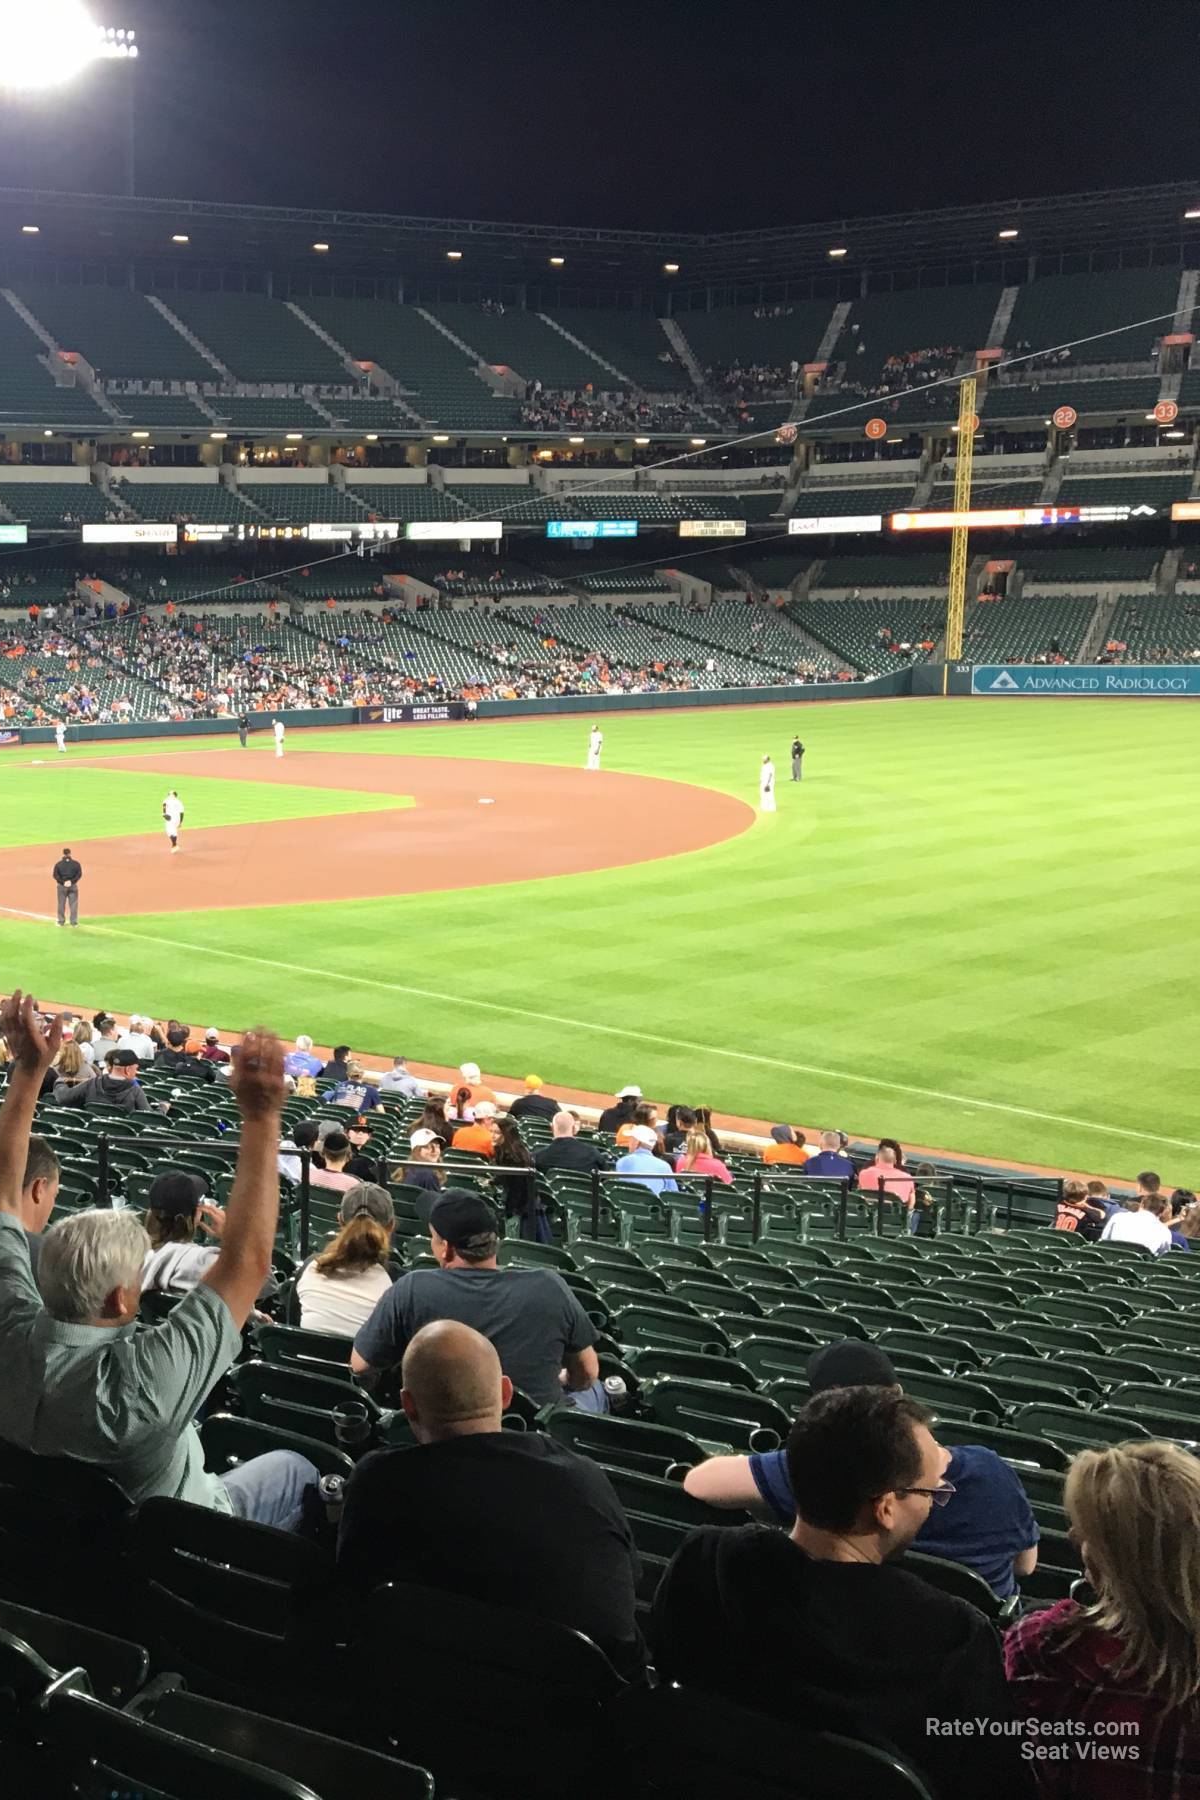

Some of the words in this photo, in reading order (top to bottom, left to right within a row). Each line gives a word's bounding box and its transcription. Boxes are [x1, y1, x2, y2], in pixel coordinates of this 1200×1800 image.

[1158, 405, 1174, 417] 33
[1057, 412, 1073, 423] 22
[872, 424, 880, 434] 5
[1024, 675, 1099, 689] ADVANCED
[1106, 675, 1191, 690] RADIOLOGY
[383, 707, 402, 722] Lite
